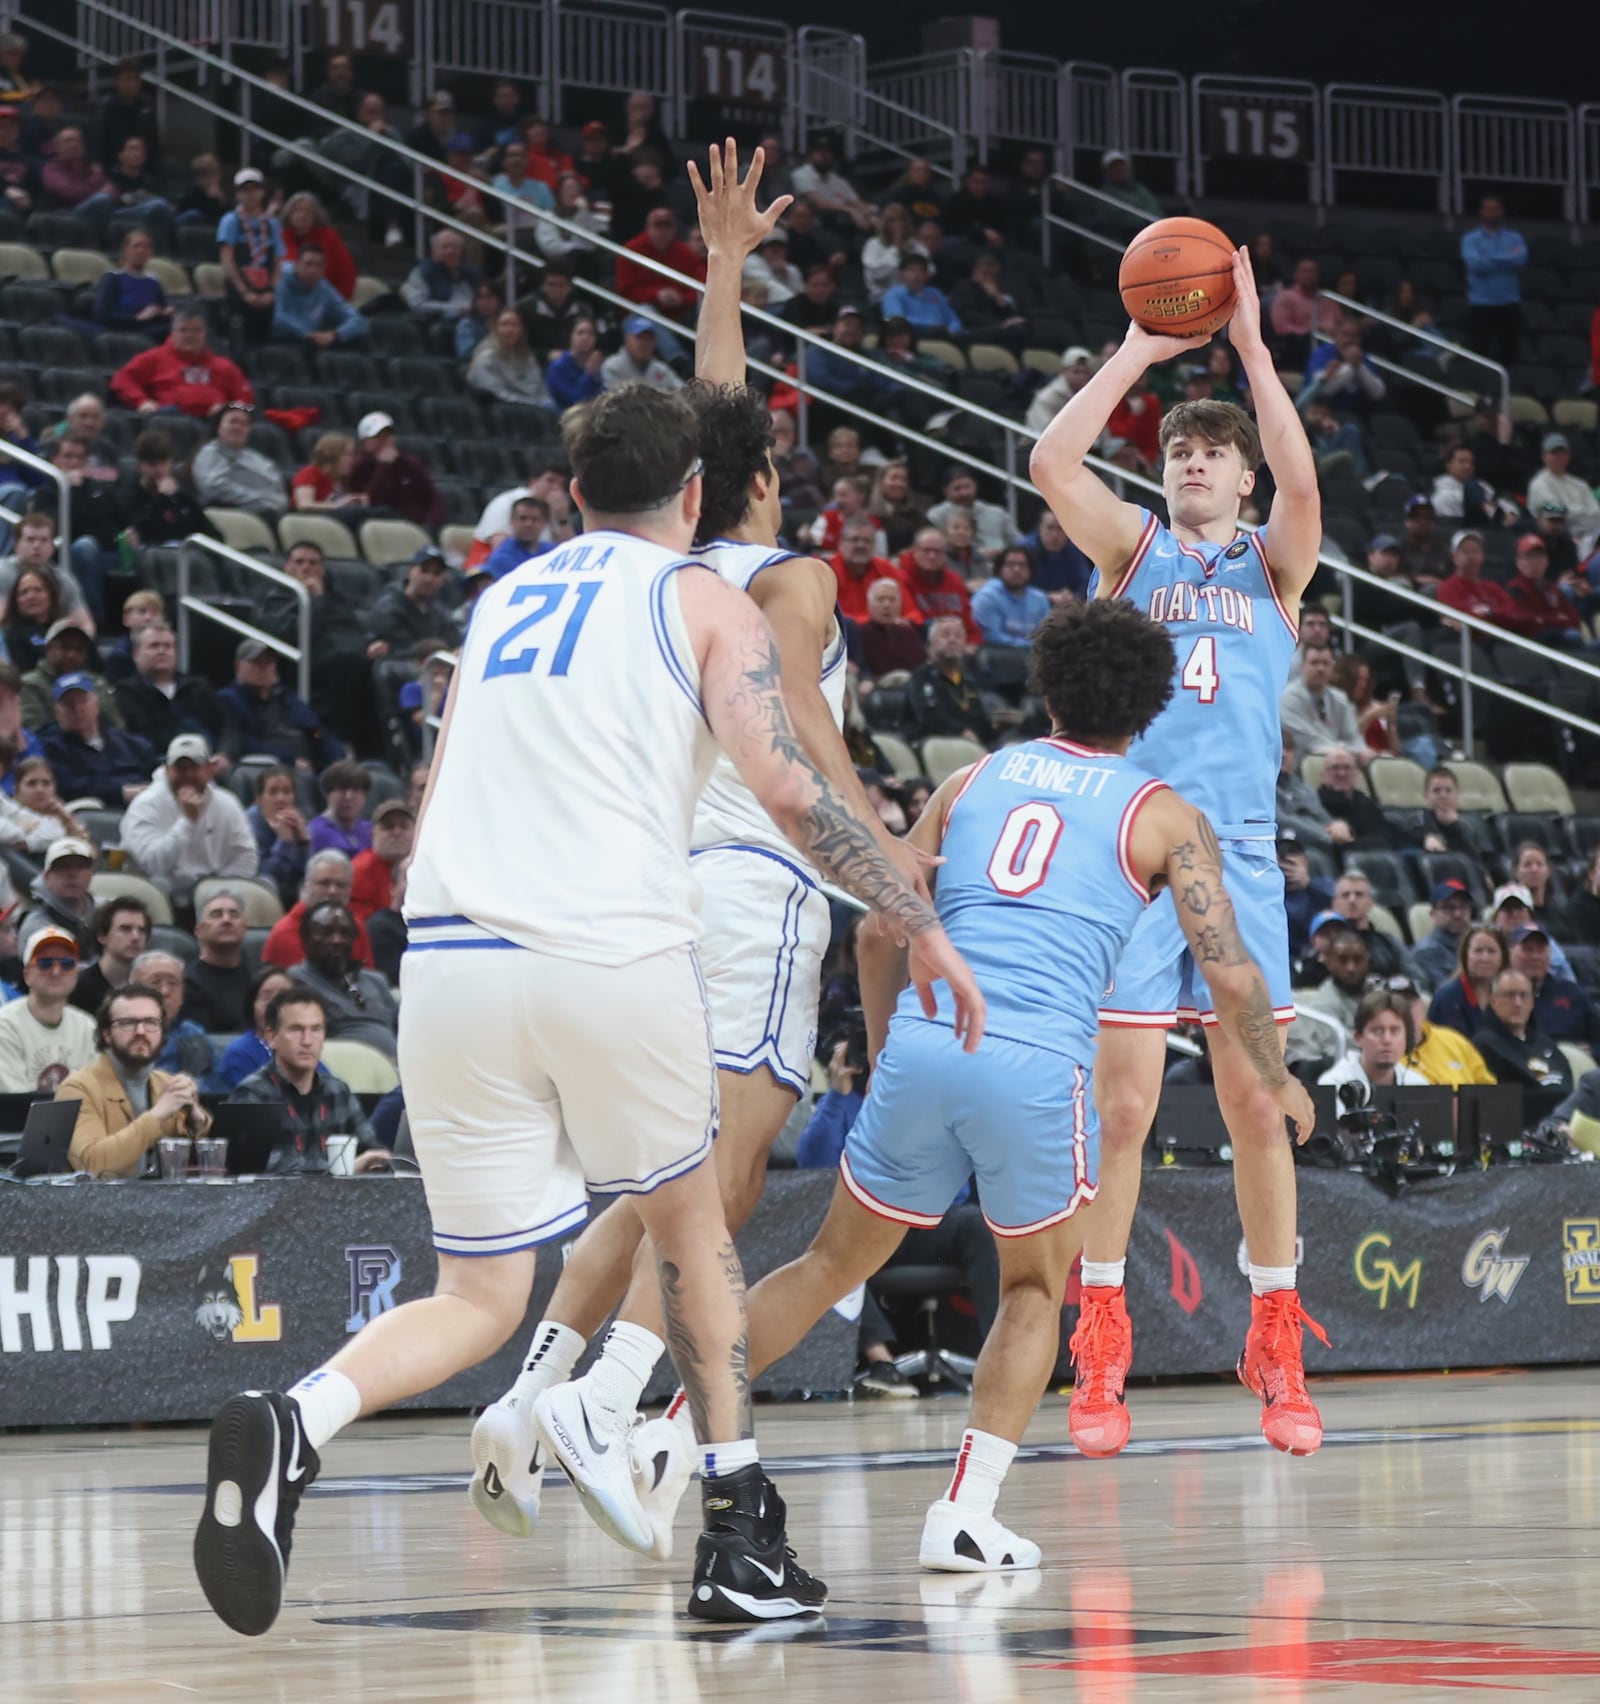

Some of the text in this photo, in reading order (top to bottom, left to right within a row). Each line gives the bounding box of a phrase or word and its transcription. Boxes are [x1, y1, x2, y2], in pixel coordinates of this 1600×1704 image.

[322, 0, 402, 54] 114
[703, 44, 777, 102] 114
[1221, 107, 1299, 159] 115
[540, 545, 616, 575] AVILA
[482, 580, 605, 682] 21
[1150, 582, 1254, 635] DAYTON
[1182, 636, 1219, 704] 4
[998, 751, 1117, 798] BENNETT
[986, 800, 1065, 898] 0
[0, 1254, 141, 1352] HIP
